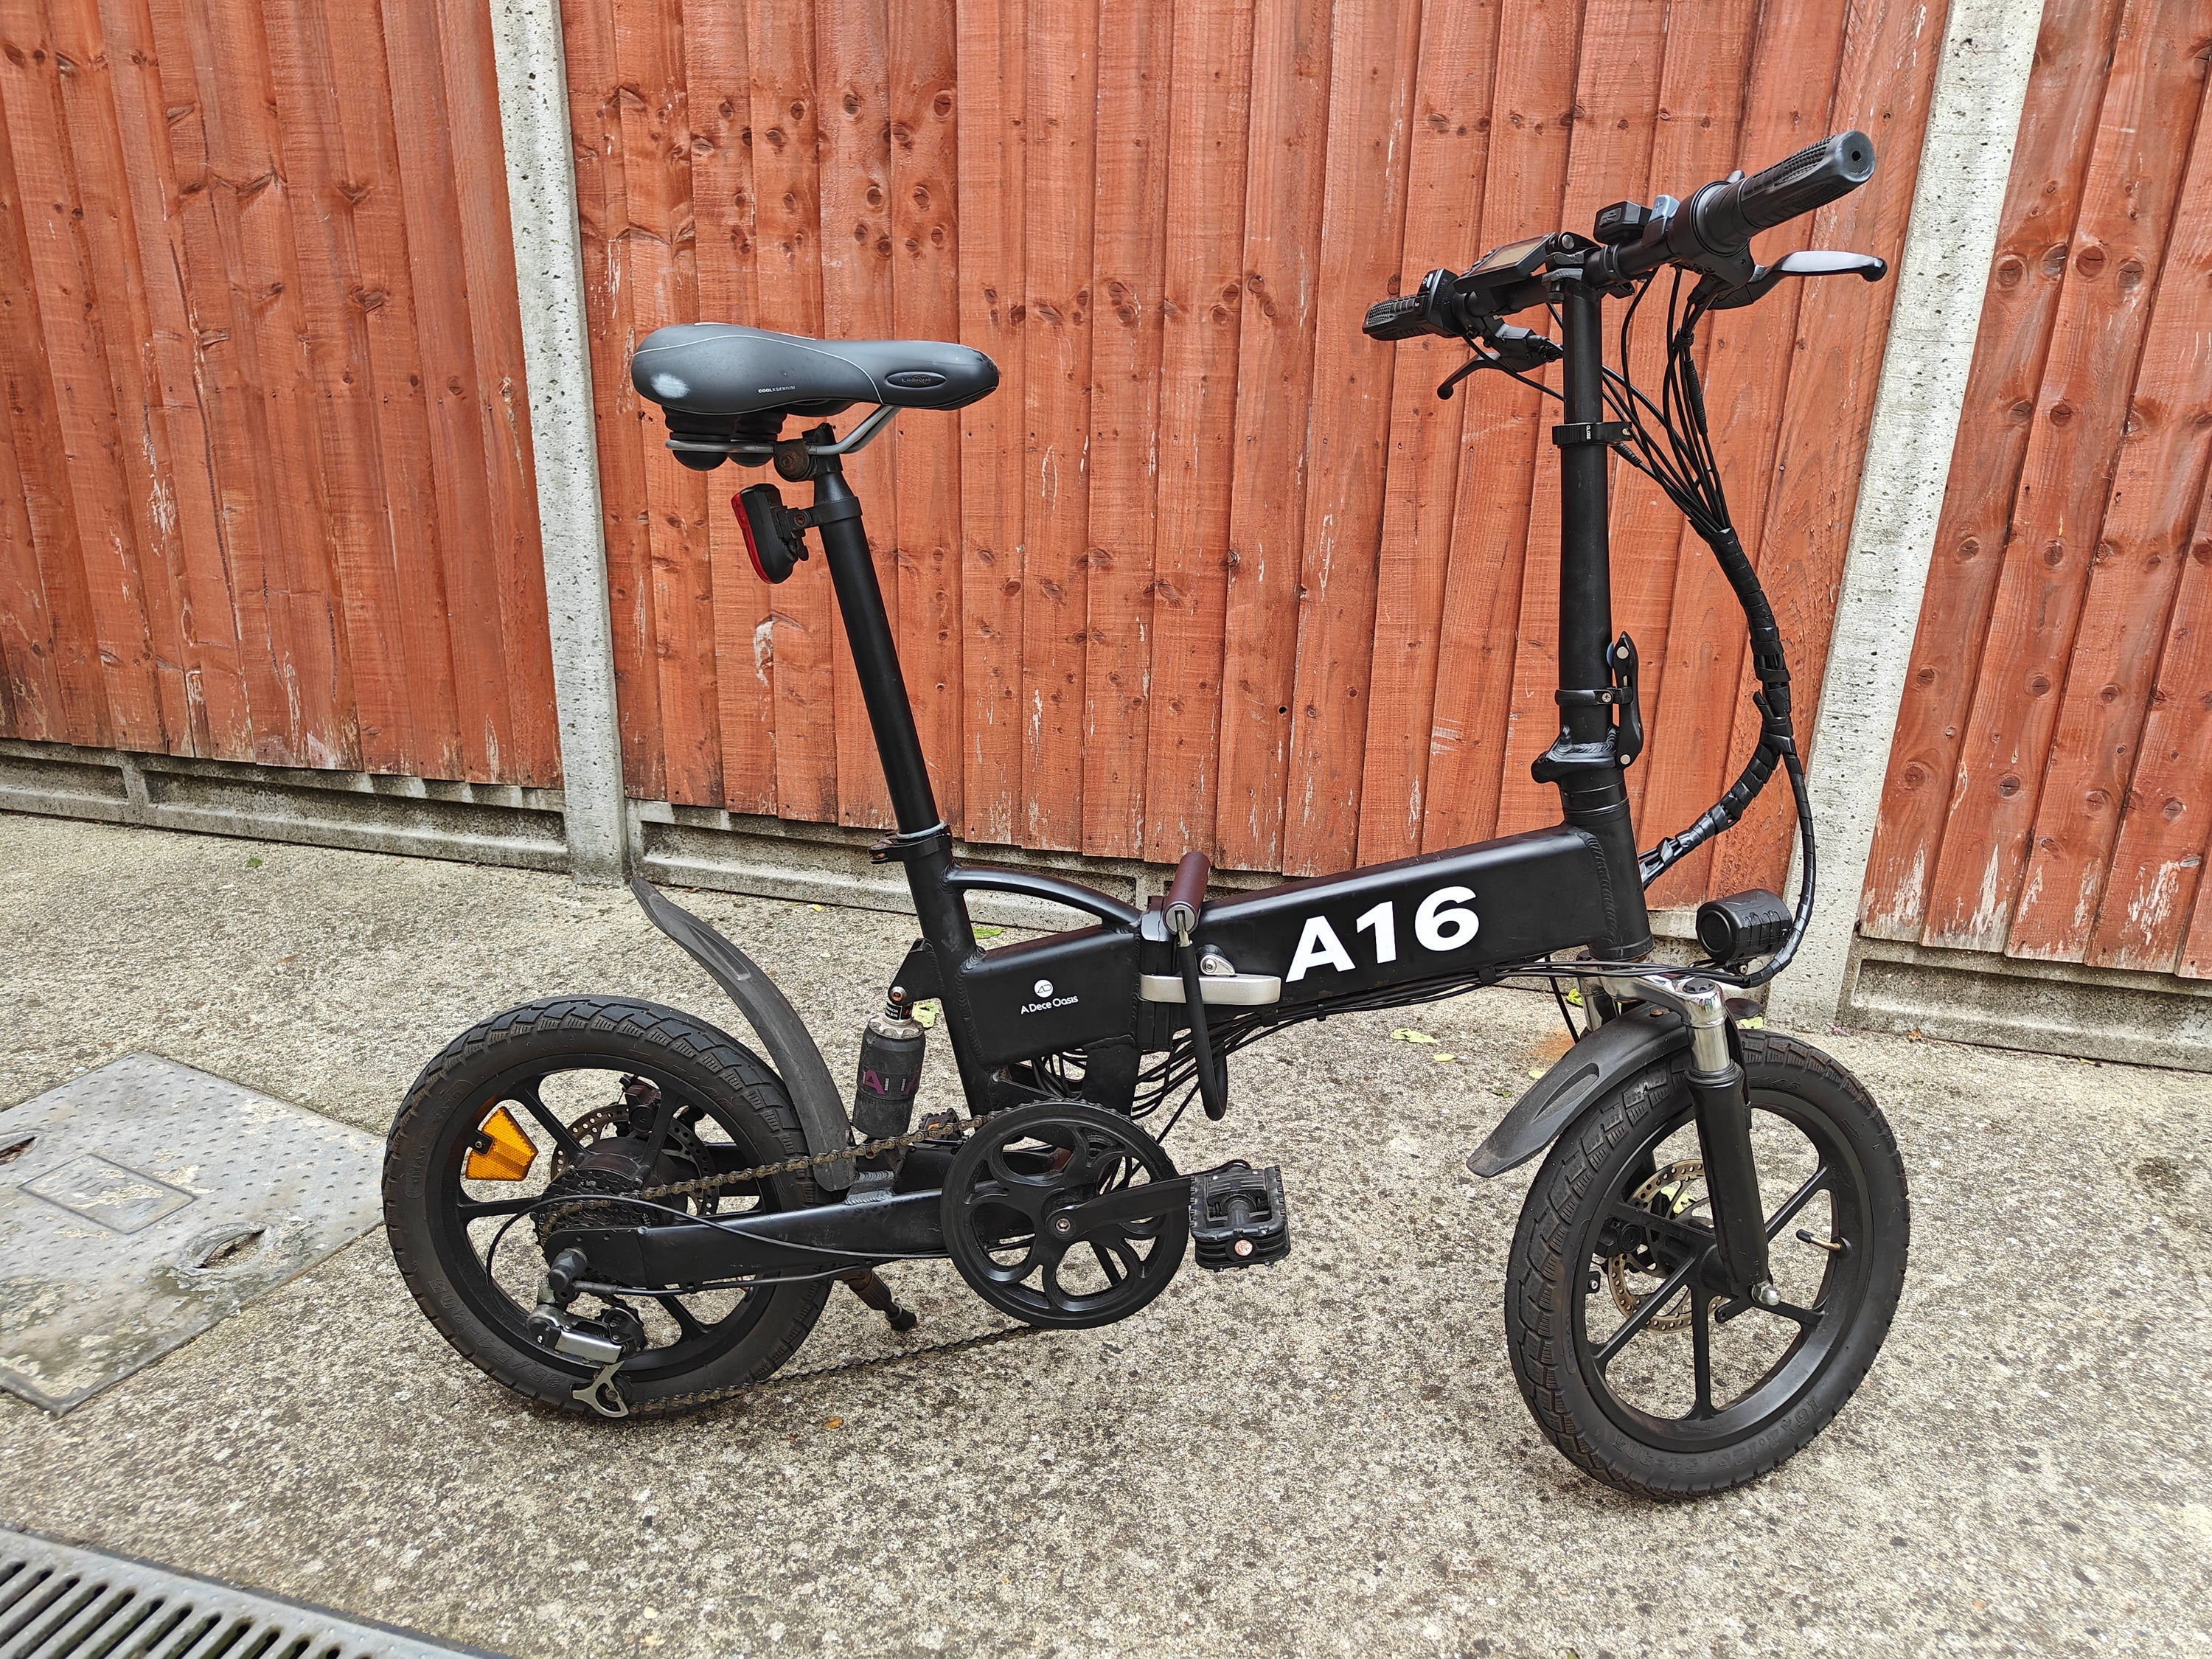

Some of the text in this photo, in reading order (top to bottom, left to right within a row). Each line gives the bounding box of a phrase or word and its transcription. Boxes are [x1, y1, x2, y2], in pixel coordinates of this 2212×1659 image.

[1285, 886, 1479, 983] A16
[1020, 995, 1079, 1015] A Dece Oasis
